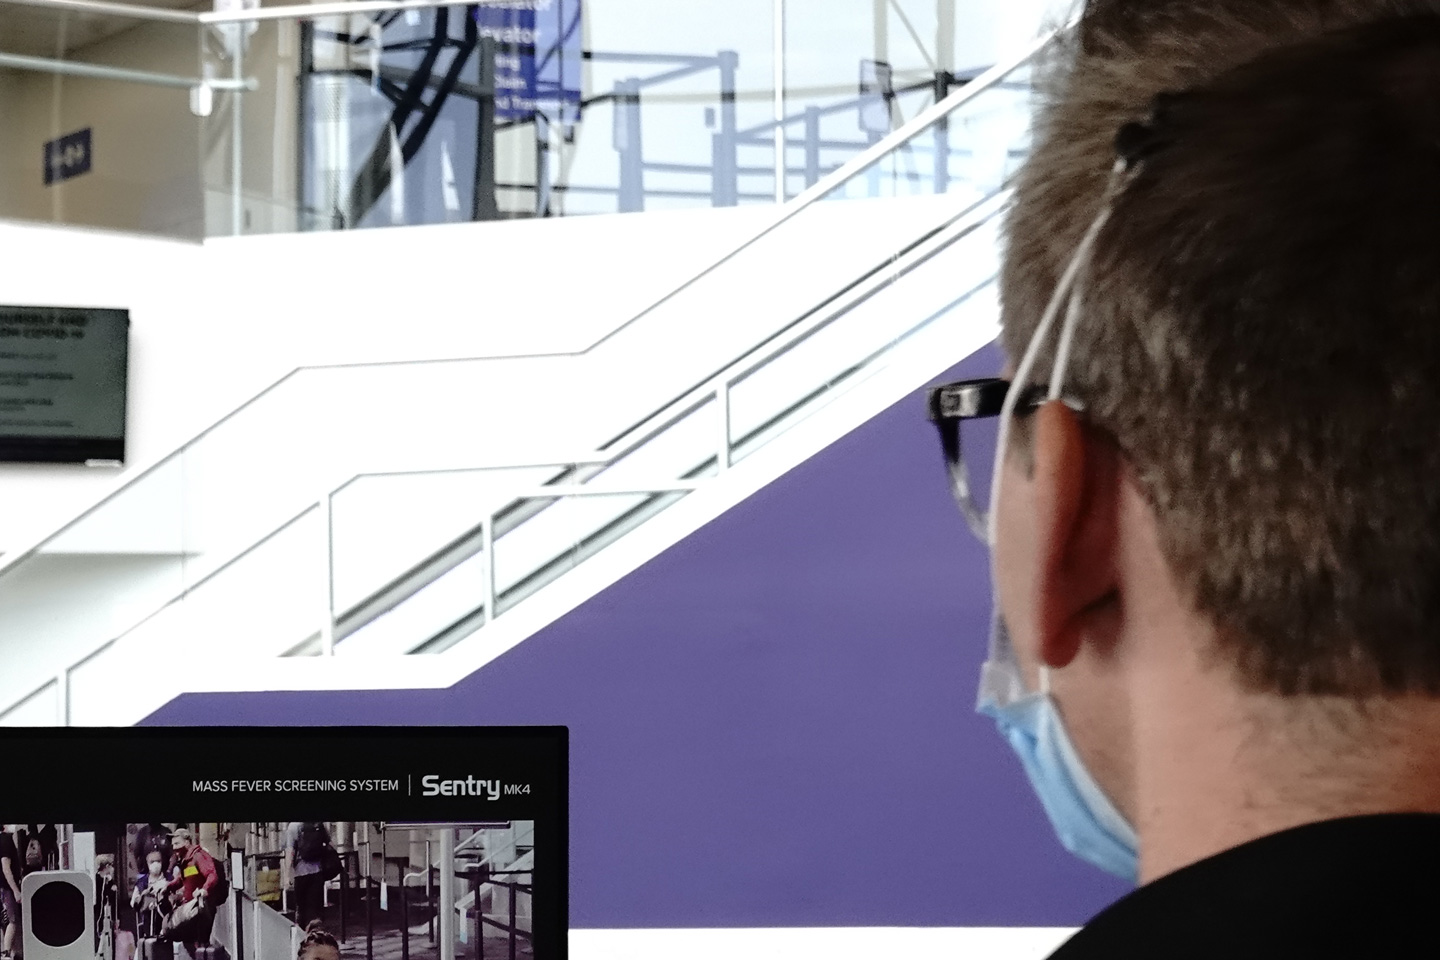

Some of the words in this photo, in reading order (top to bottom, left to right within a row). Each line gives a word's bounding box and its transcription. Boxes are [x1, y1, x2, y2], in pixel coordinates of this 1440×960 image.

[192, 780, 228, 792] MASS
[231, 780, 271, 792] FEVER
[274, 780, 346, 792] SCREENING
[349, 779, 399, 791] SYSTEM
[421, 774, 501, 801] Sentry
[504, 784, 531, 796] MK4
